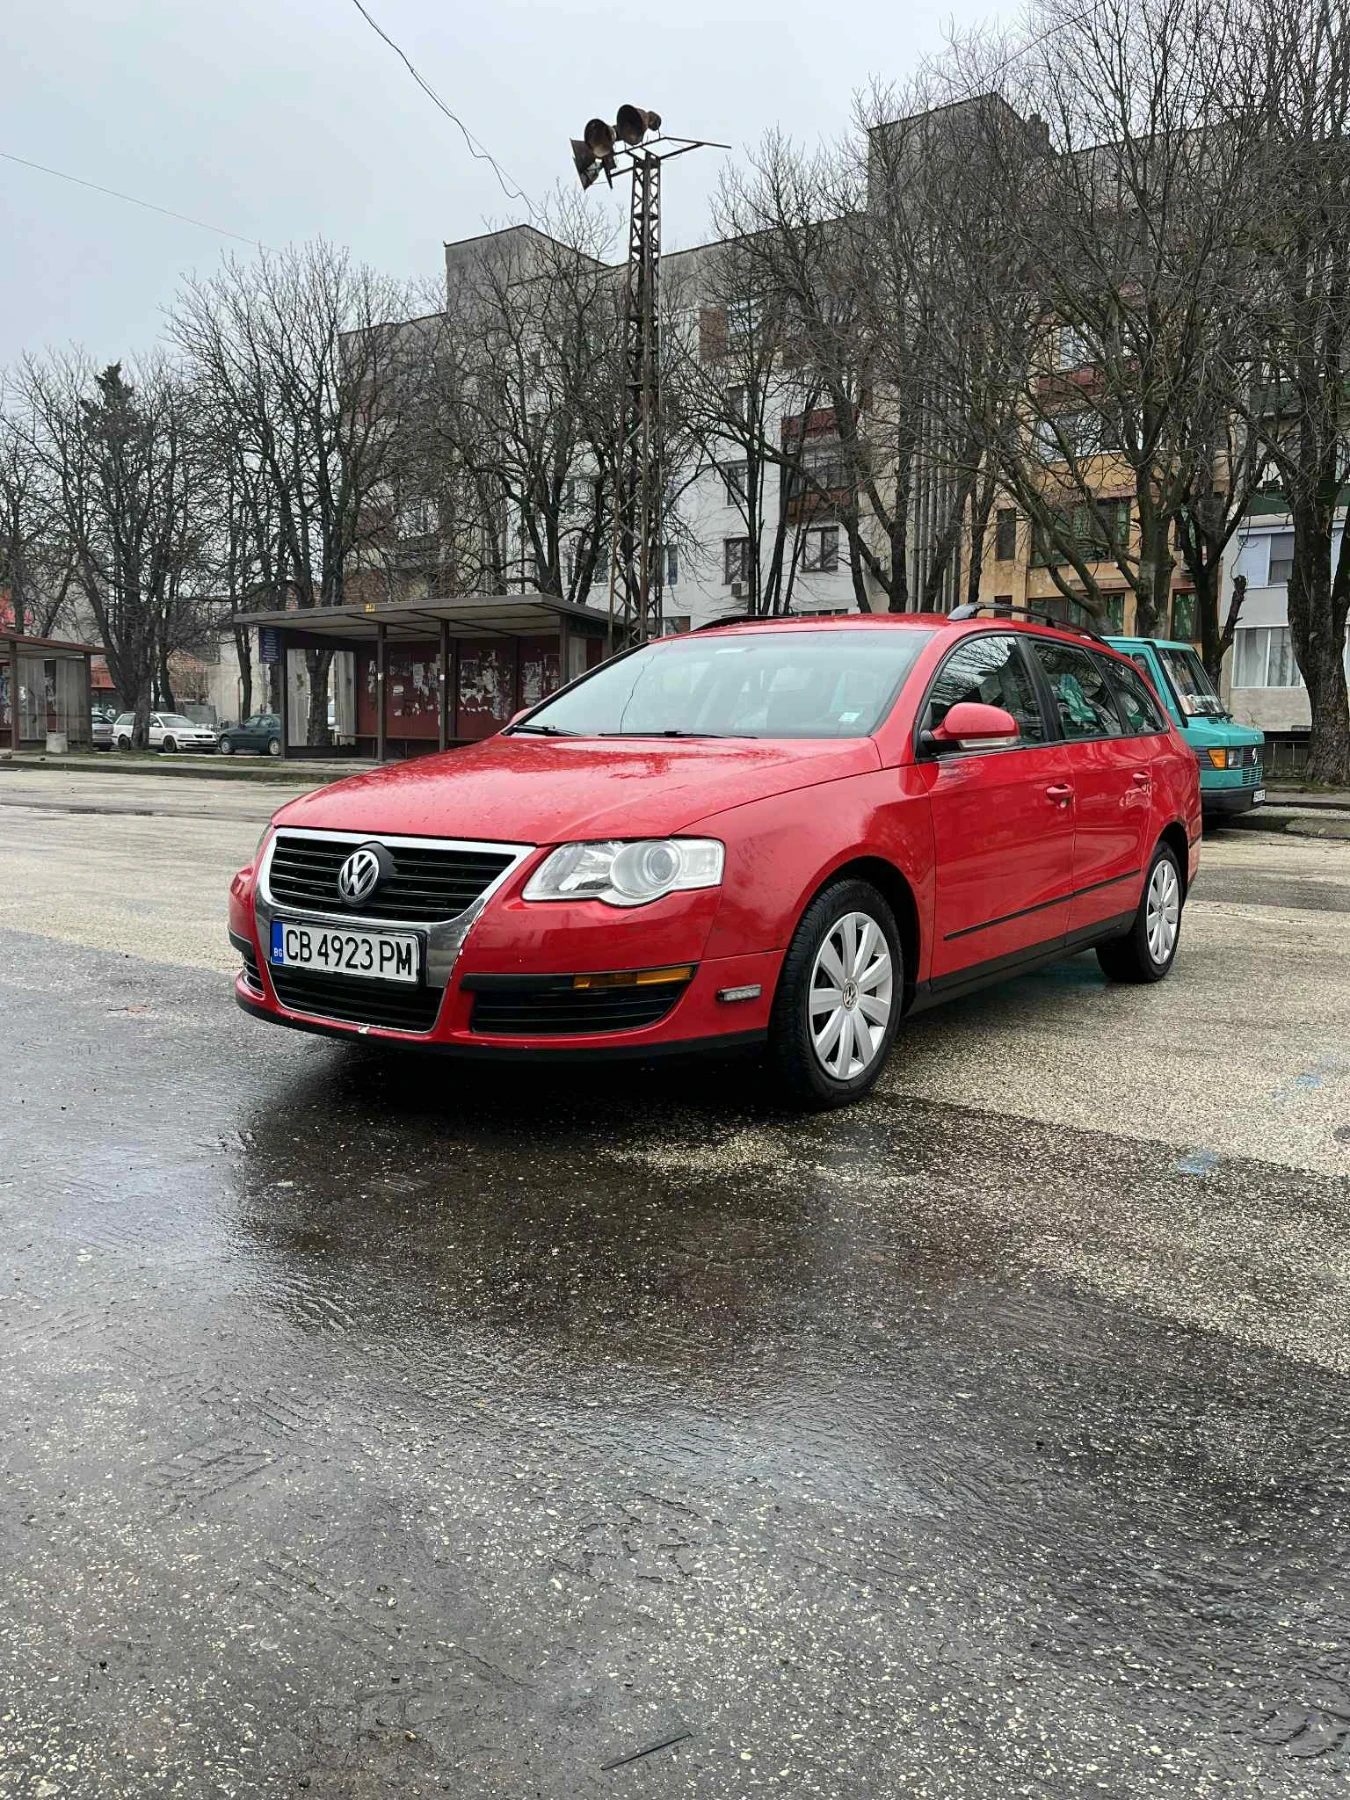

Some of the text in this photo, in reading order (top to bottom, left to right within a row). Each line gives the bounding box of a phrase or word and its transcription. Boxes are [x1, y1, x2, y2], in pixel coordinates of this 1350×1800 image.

[339, 850, 379, 902] VW
[273, 947, 283, 958] BG
[286, 929, 412, 976] CB 4923 PM
